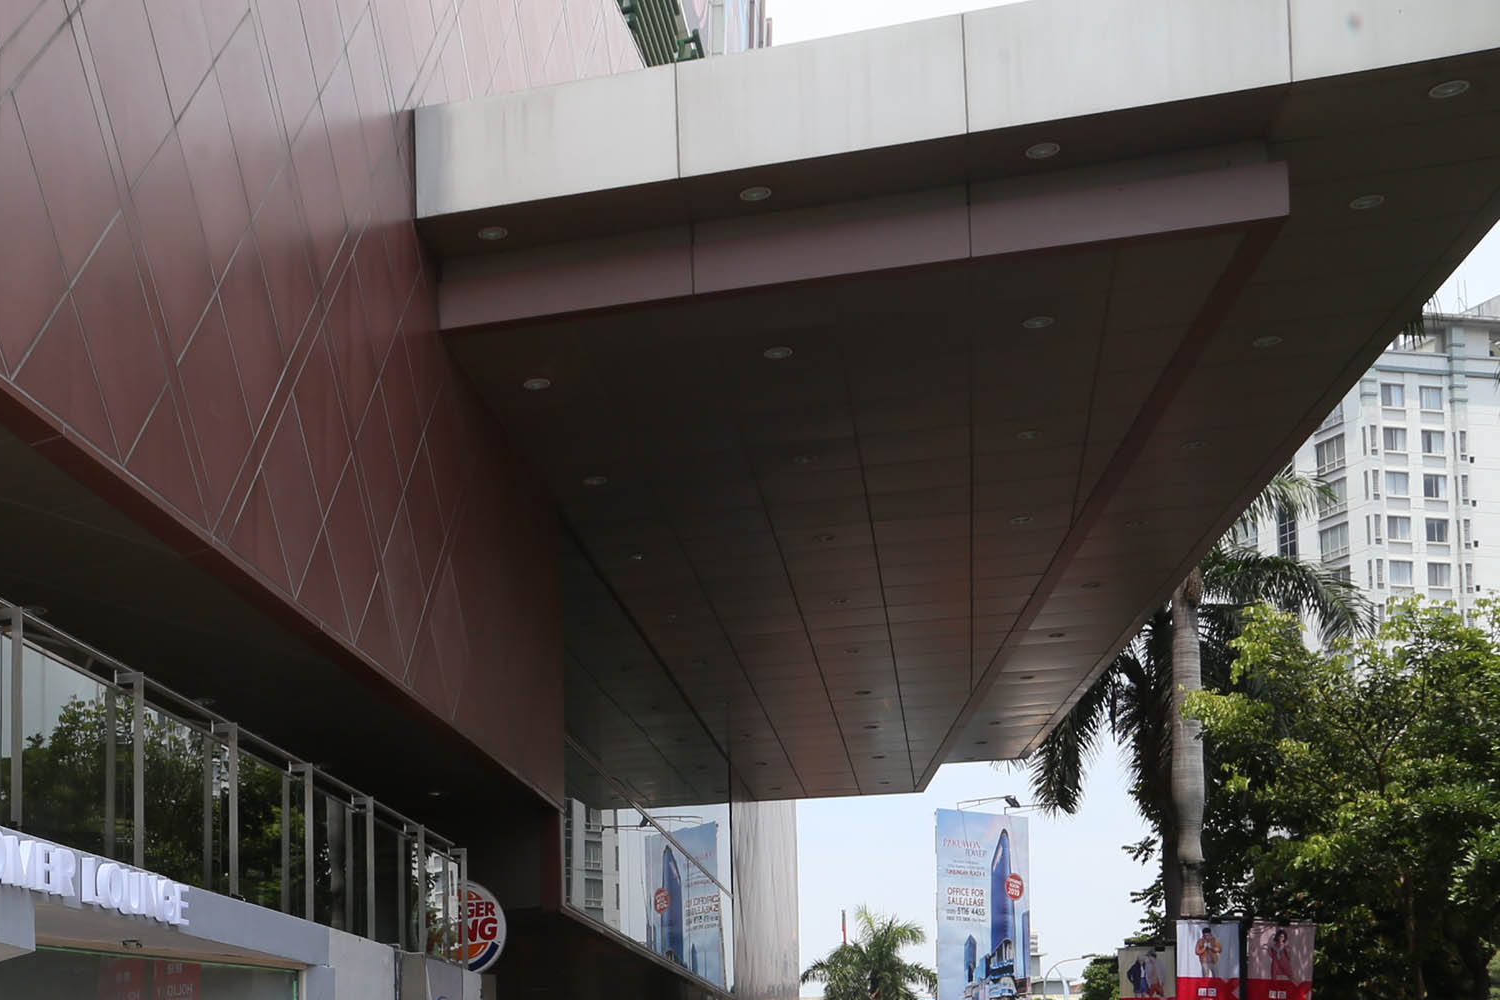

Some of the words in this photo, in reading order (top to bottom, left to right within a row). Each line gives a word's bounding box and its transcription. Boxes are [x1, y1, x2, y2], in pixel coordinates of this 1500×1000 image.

[80, 857, 190, 926] LOUNGE
[947, 887, 969, 896] OFFICE
[971, 888, 984, 897] FOR
[947, 896, 985, 907] SALE/LEASE
